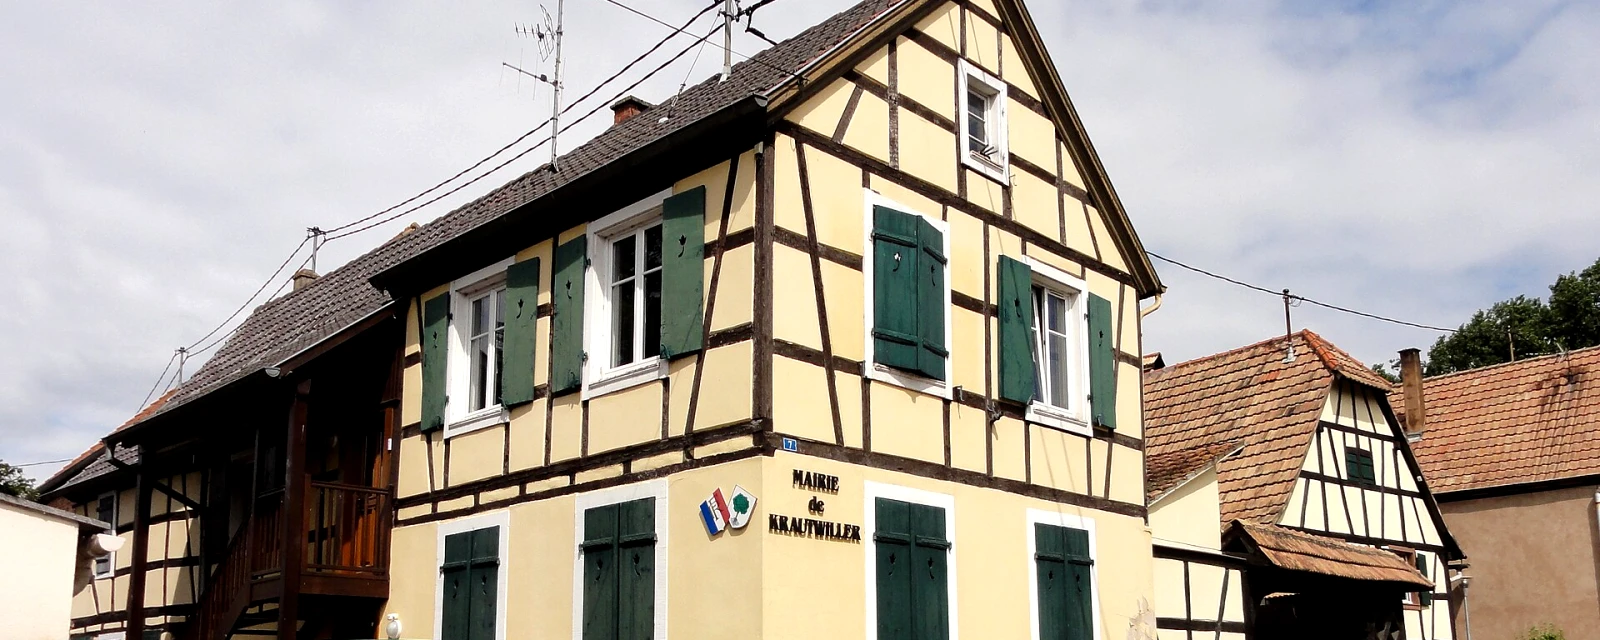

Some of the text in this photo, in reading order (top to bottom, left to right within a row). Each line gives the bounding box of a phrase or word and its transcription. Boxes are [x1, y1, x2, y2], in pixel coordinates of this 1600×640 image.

[792, 469, 840, 493] MAIRIE
[808, 496, 825, 513] de
[768, 513, 862, 541] KRAUTWILLER
